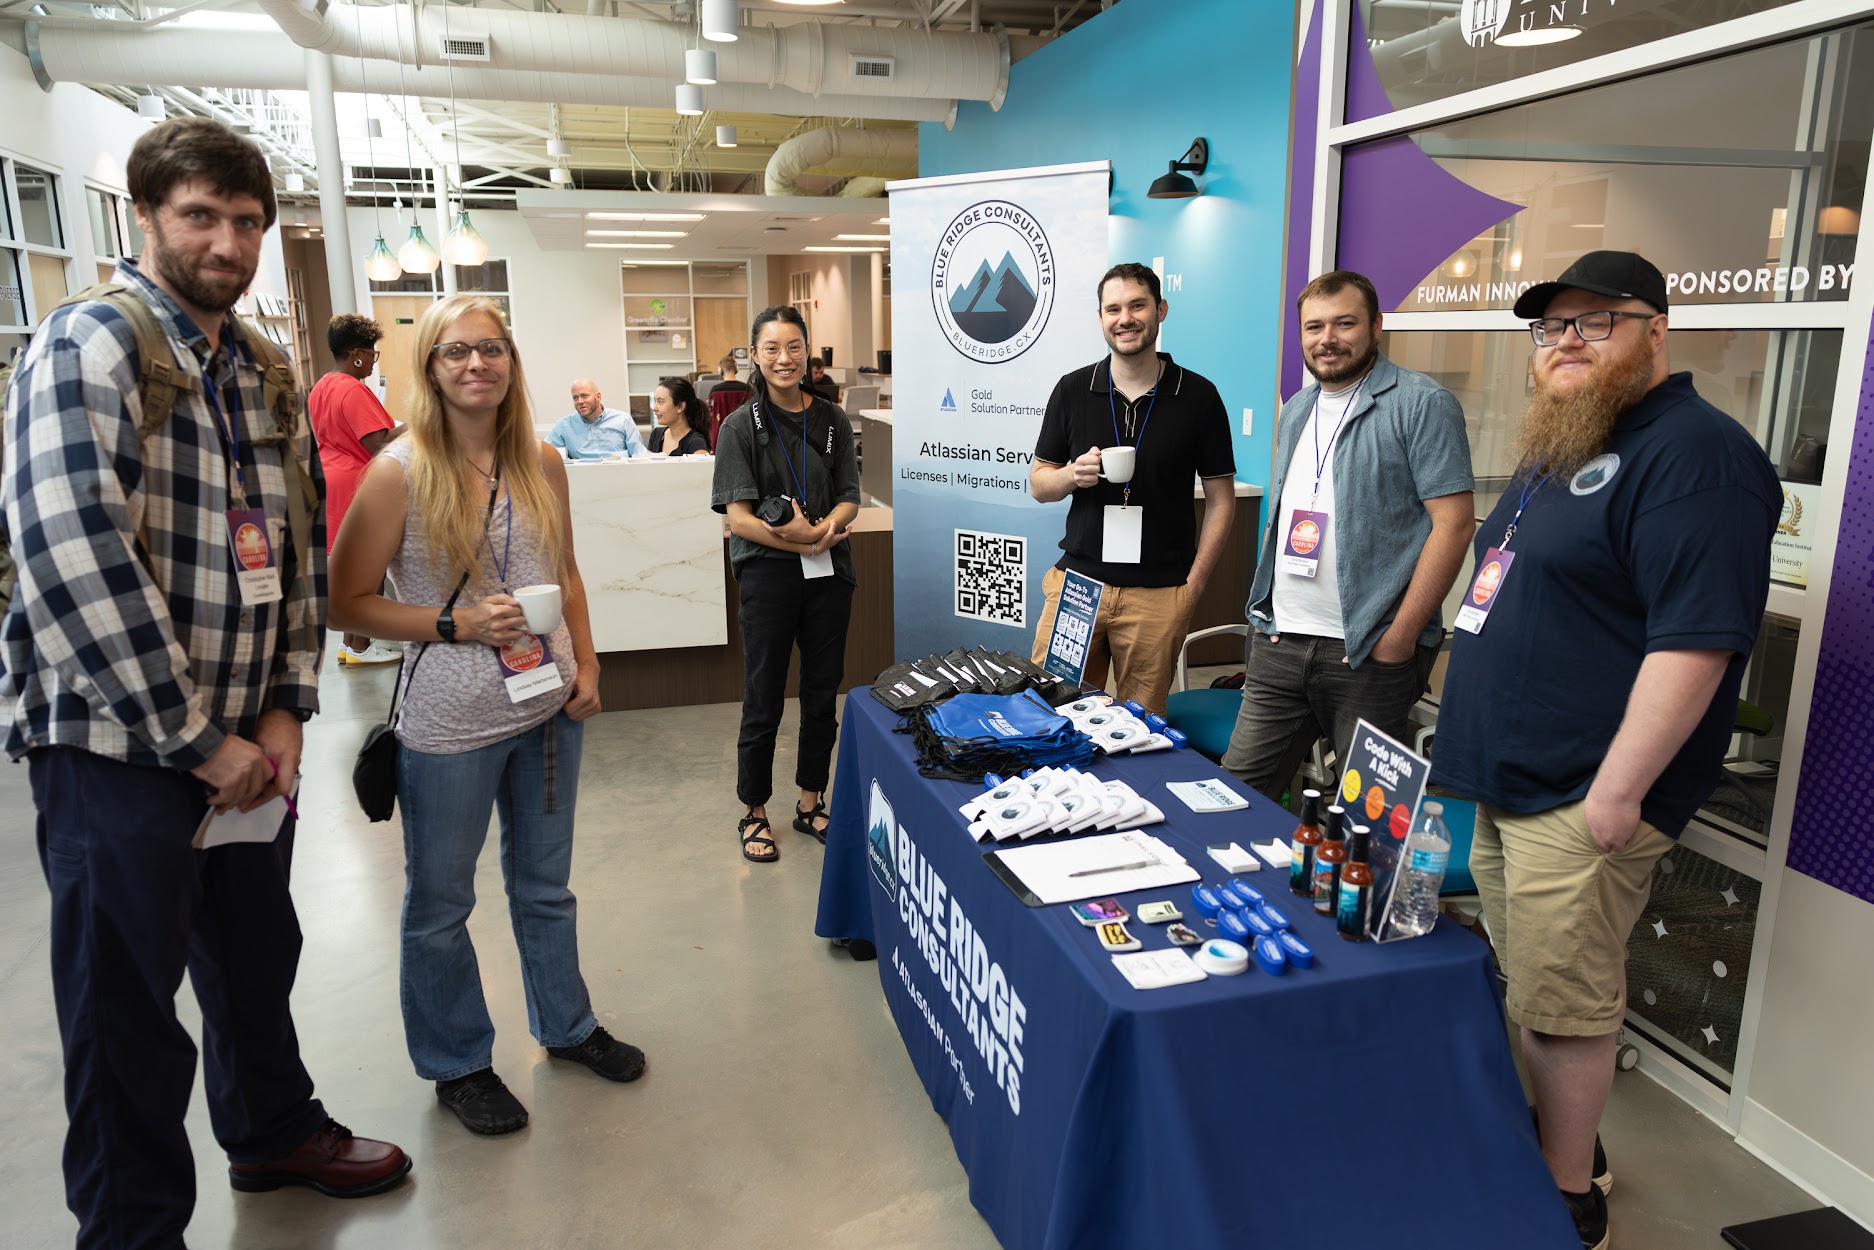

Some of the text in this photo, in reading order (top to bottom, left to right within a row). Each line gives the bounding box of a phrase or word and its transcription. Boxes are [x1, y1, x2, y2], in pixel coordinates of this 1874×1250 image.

[1519, 0, 1616, 33] UNI
[935, 206, 1051, 288] BLUE RIDGE CONSULTANTS
[1166, 273, 1182, 292] TM
[1417, 279, 1557, 304] FURMAN INNO
[1663, 263, 1855, 296] PONSORED BY
[952, 331, 1031, 358] BLUERIDGE.CX
[971, 389, 993, 400] Gold
[971, 402, 1046, 416] Solution Partner
[752, 401, 763, 430] LUMIX
[825, 425, 835, 454] LUMIX
[919, 441, 1034, 465] Atlassian Serv
[901, 468, 948, 483] Licenses
[957, 473, 1020, 490] Migrations
[1772, 555, 1803, 570] University
[509, 652, 541, 668] CAROLINA
[1364, 736, 1413, 779] Code With
[1368, 757, 1378, 772] A
[1377, 761, 1399, 787] Kick
[898, 822, 1027, 1075] BLUE RIDGE
[899, 884, 1021, 1117] CONSULTANTS
[899, 960, 975, 1106] ATLASSIAN Partner
